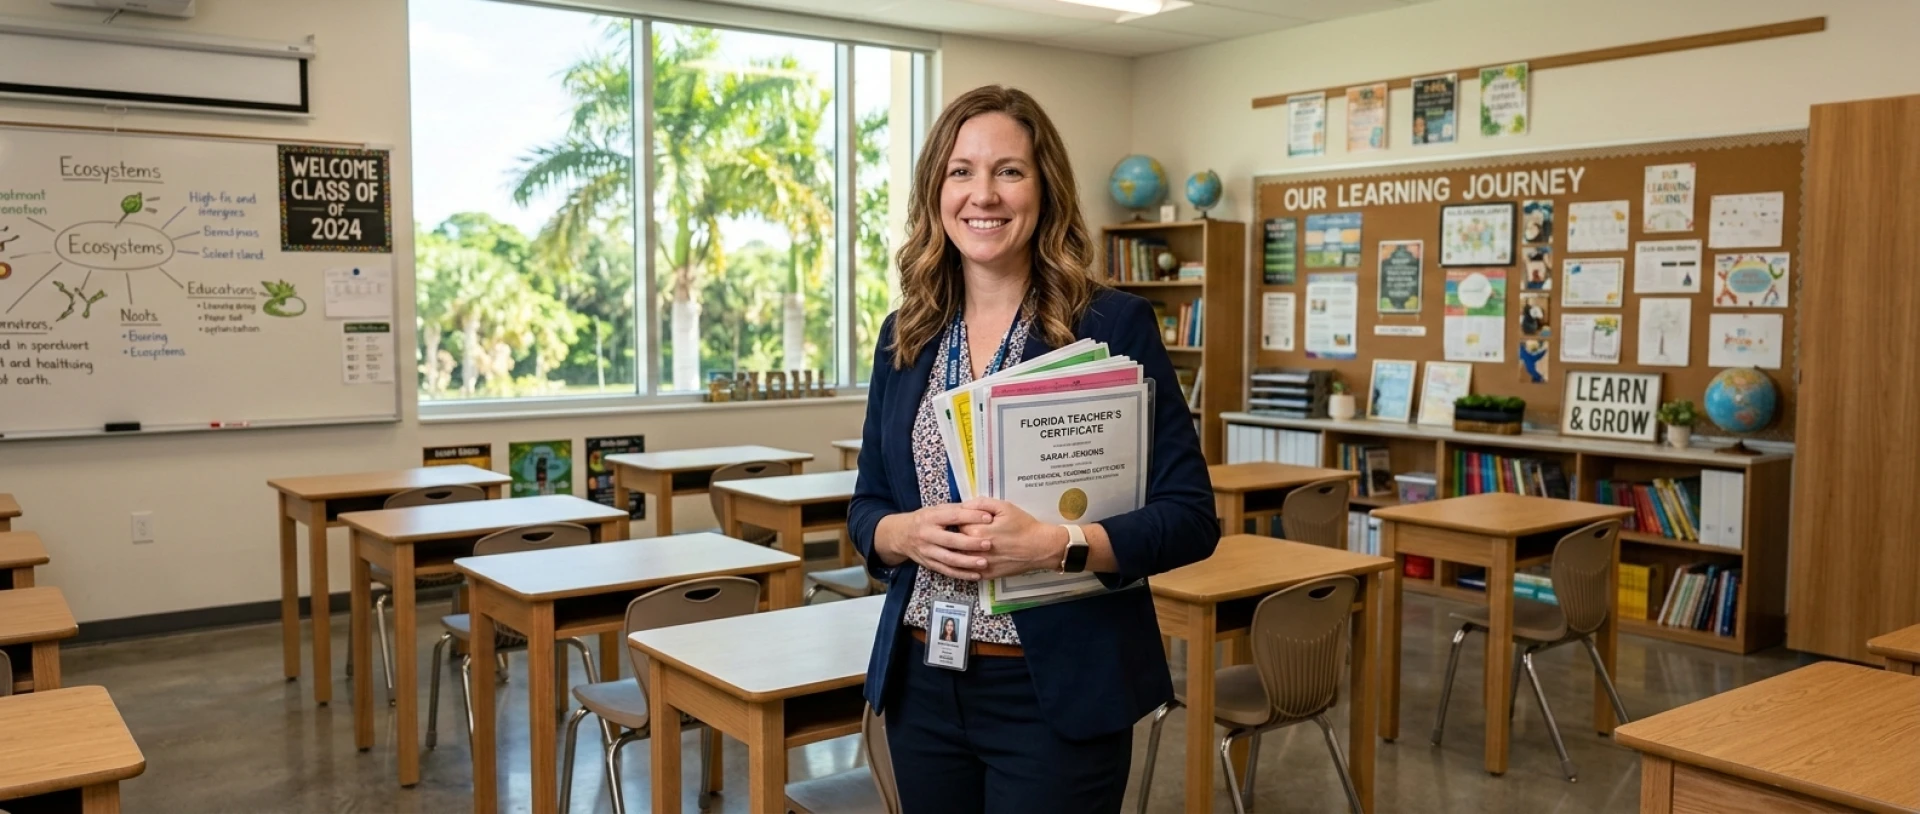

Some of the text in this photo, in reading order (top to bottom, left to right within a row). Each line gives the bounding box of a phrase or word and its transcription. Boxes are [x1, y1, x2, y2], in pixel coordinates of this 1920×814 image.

[60, 155, 161, 184] Ecosystems
[290, 155, 378, 180] WELCOME
[291, 179, 378, 203] CLASS OF
[1284, 167, 1585, 211] OUR LEARNING JOURNEY
[328, 203, 345, 217] OF
[311, 217, 362, 240] 2024
[69, 234, 164, 261] Ecosystems
[1577, 375, 1648, 405] LEARN
[1020, 410, 1122, 428] FLORIDA TEACHER'S
[1040, 424, 1104, 439] CERTIFICATE
[1570, 406, 1650, 435] & GROW
